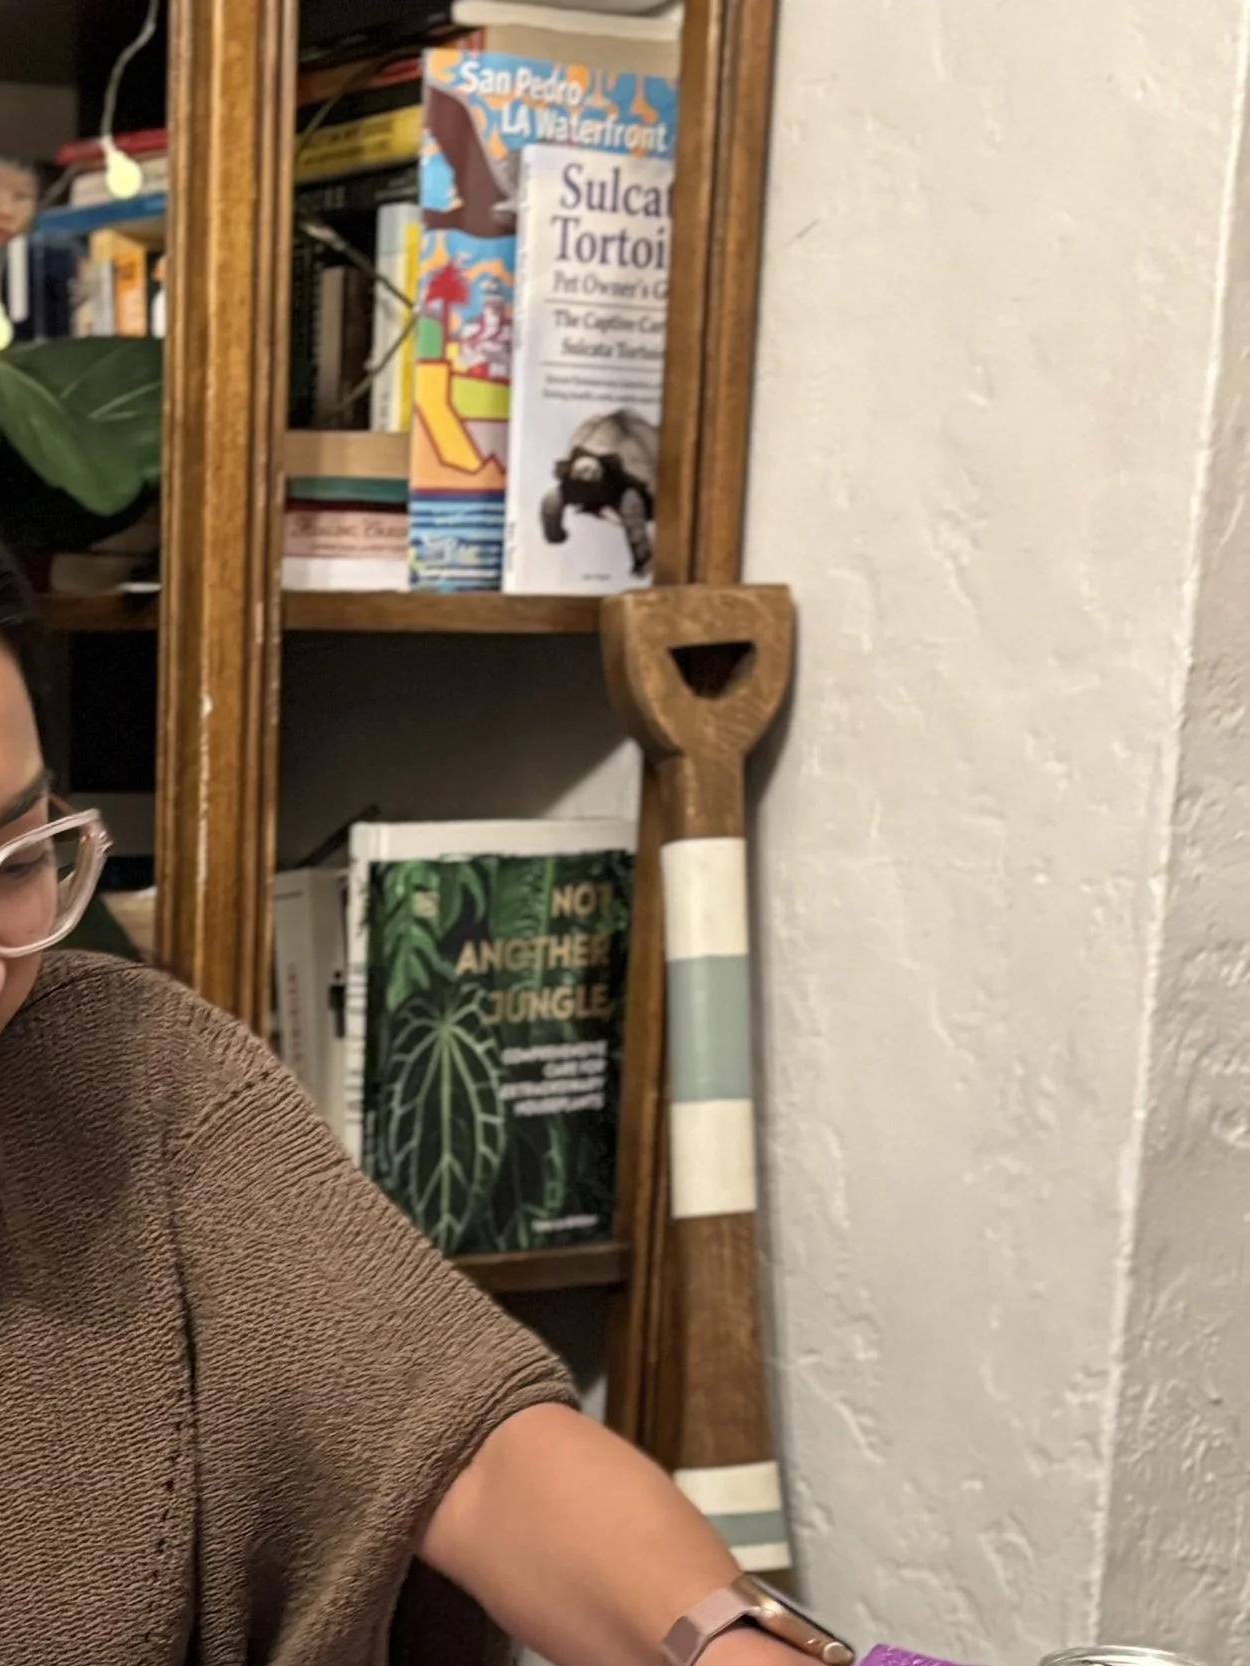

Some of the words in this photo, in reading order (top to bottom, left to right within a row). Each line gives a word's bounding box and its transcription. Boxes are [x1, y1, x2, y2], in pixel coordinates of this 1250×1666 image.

[459, 59, 510, 95] San
[502, 104, 531, 138] LA
[535, 111, 669, 152] Waterfront
[551, 883, 613, 919] NOT
[455, 933, 611, 976] ANOTHER
[484, 984, 610, 1025] JUNGLE
